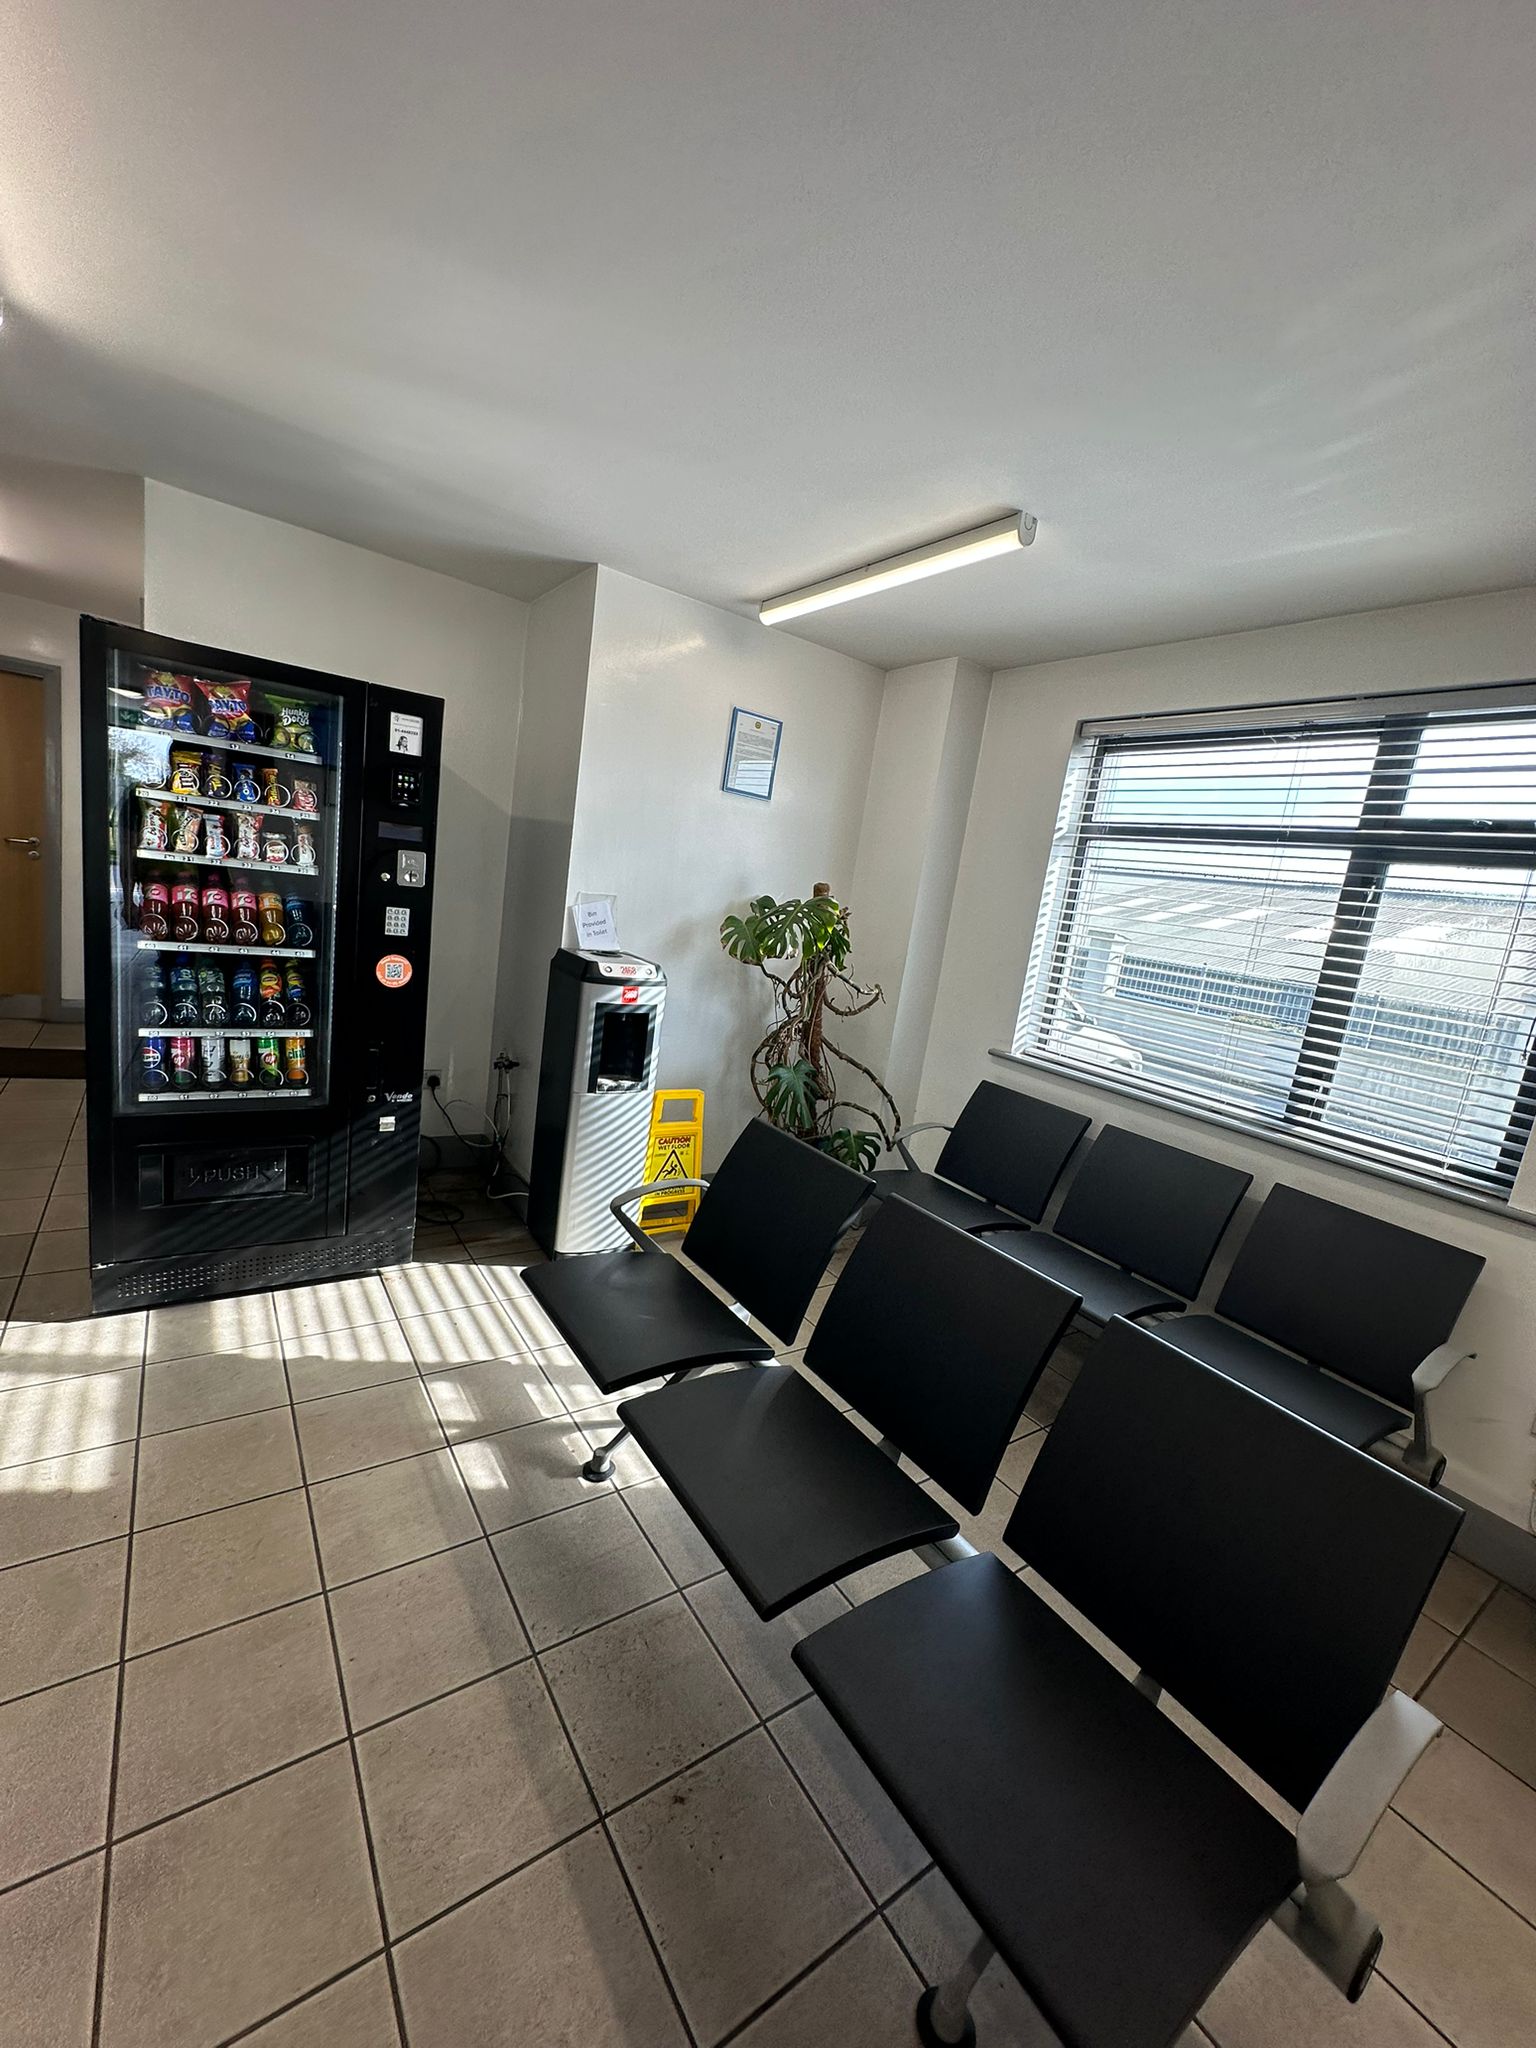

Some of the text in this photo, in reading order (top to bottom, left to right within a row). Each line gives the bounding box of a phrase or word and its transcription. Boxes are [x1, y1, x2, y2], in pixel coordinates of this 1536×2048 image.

[281, 707, 309, 718] Hunky
[582, 919, 606, 928] Provided
[658, 1136, 691, 1145] CAUTION
